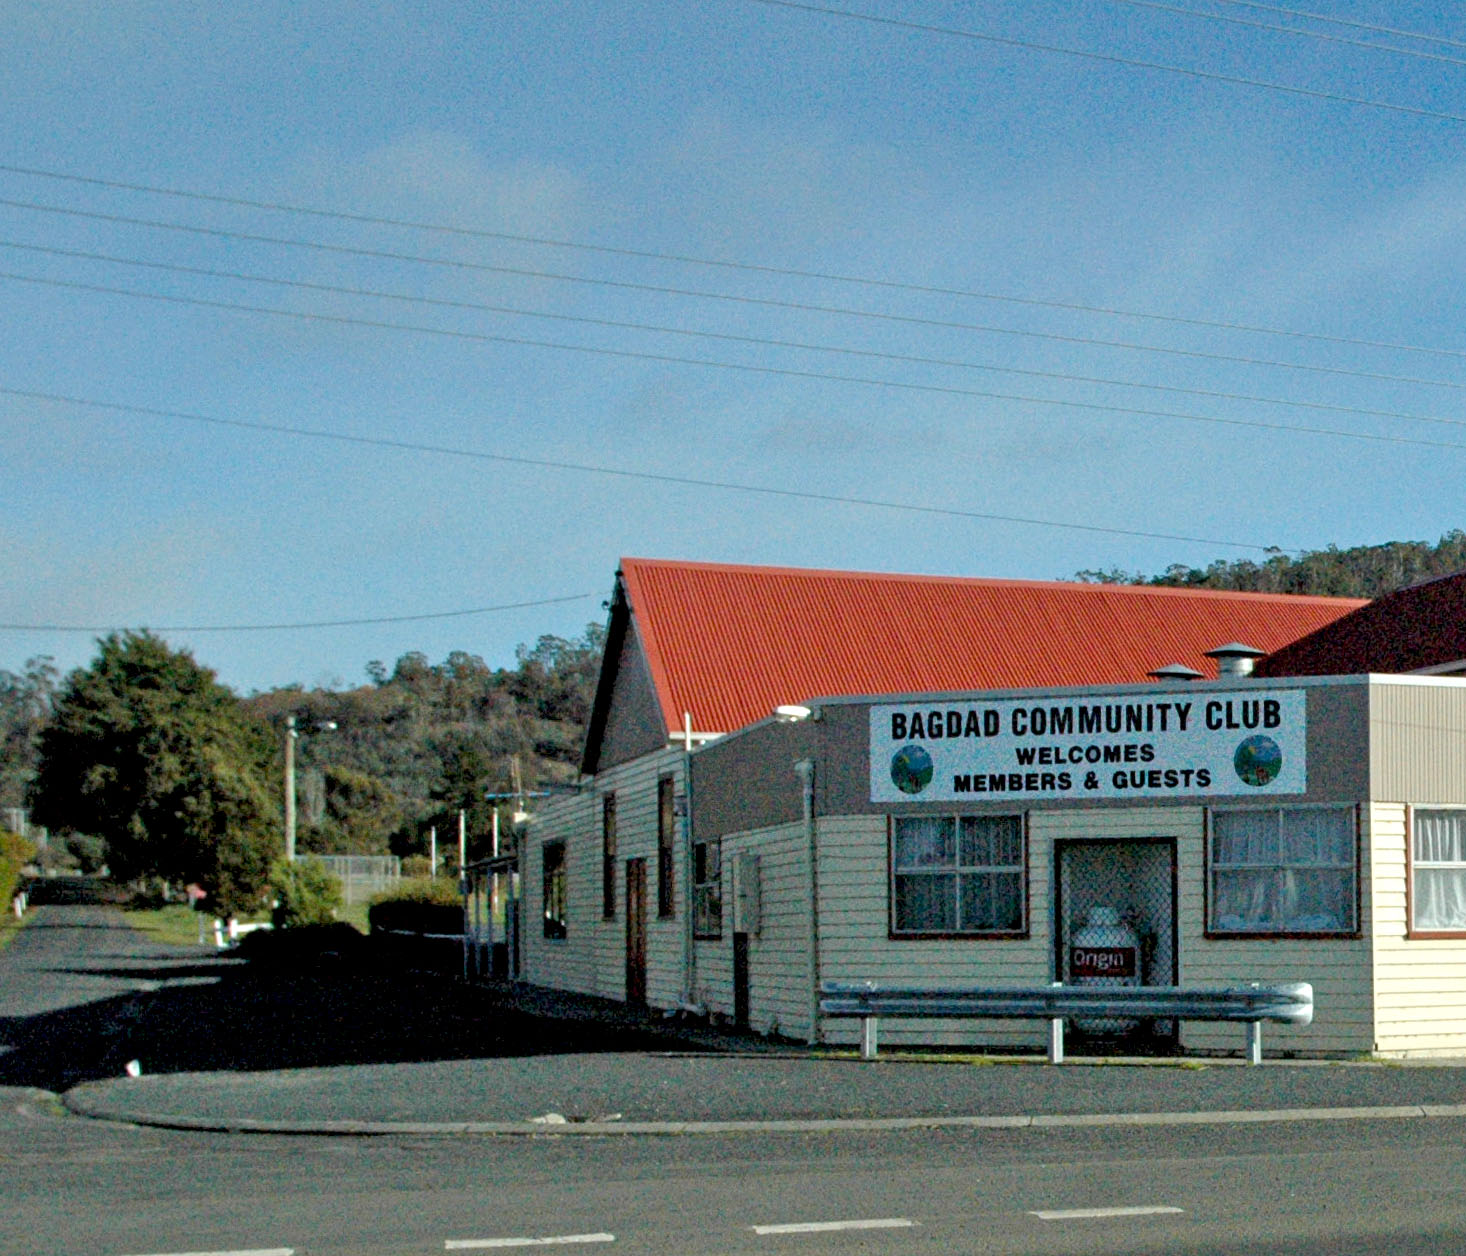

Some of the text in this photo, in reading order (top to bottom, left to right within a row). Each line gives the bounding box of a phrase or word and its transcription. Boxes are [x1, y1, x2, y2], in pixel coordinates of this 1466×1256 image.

[891, 699, 1282, 740] BAGDAD COMMUNITY CLUB
[1016, 743, 1156, 766] WELCOMES
[953, 768, 1212, 793] MEMBERS & GUESTS
[1074, 949, 1124, 970] Origin
